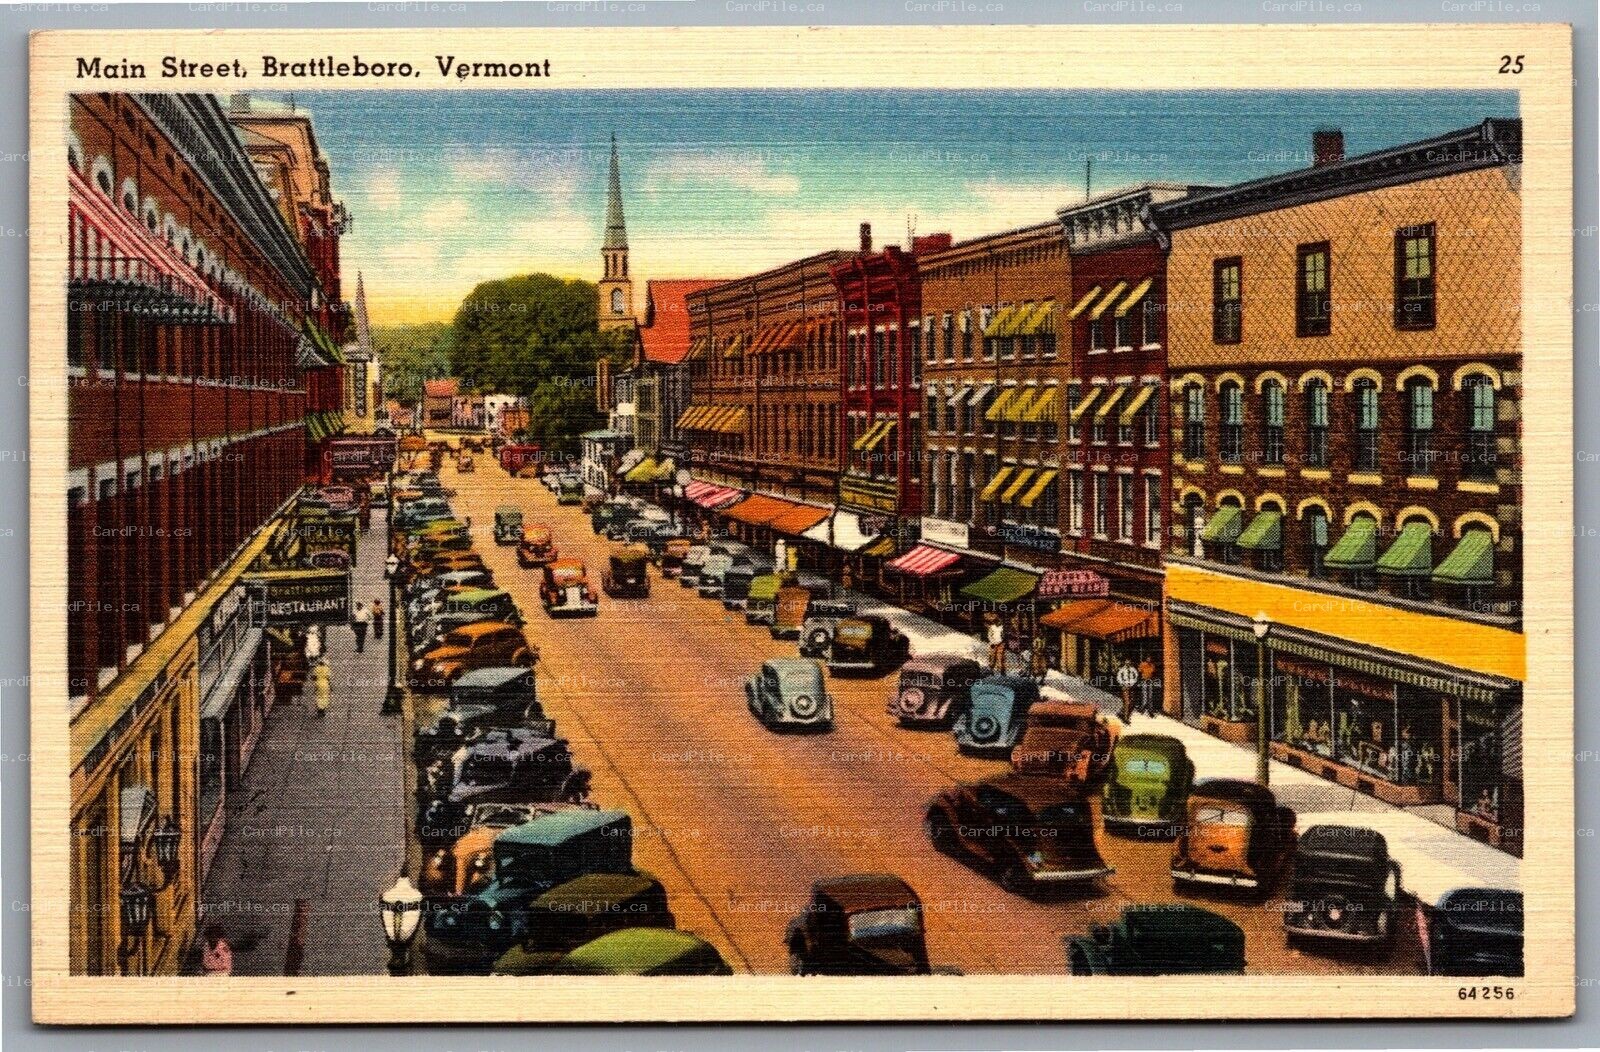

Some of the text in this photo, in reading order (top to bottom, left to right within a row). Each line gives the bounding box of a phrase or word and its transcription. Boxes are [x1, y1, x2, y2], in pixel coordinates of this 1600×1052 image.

[76, 55, 551, 80] Main Street, Brattleboro, Vermont
[1498, 54, 1525, 75] 25
[270, 597, 347, 616] RESTAURANT
